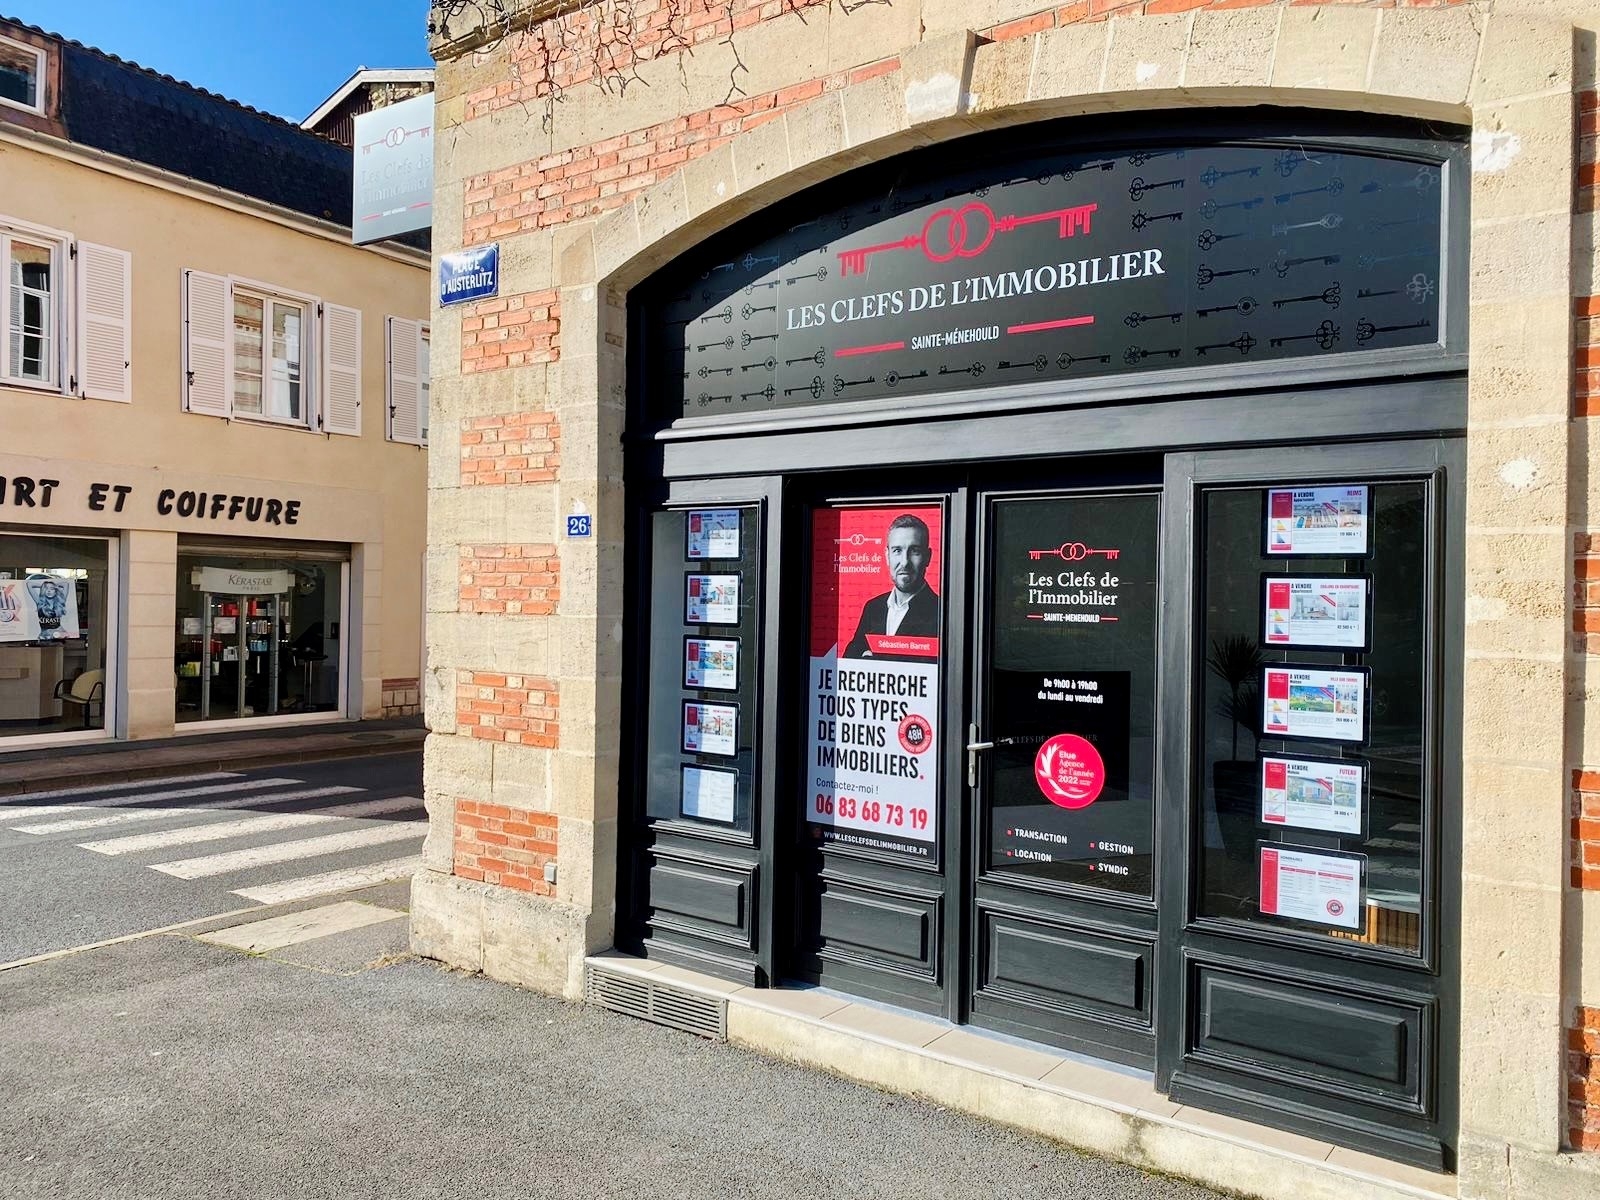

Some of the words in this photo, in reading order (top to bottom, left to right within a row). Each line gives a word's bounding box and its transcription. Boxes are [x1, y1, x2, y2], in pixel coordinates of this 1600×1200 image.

[441, 271, 494, 296] D'AUSTERLITZ
[786, 303, 826, 331] LES
[830, 290, 904, 323] CLEFS
[908, 283, 946, 312] DE
[950, 248, 1166, 306] L'IMMOBILIER
[911, 325, 1000, 350] SAINTE-MÉNEHOULD
[88, 483, 132, 512] ET
[157, 488, 302, 525] COIFFURE
[569, 517, 587, 534] 26
[834, 552, 846, 562] Les
[849, 552, 869, 562] Clefs
[871, 553, 882, 563] de
[1029, 572, 1053, 586] Les
[1057, 571, 1096, 587] Clefs
[1100, 571, 1120, 587] de
[1028, 589, 1118, 606] l'Immobilier
[878, 639, 909, 650] Sébastien
[818, 668, 833, 690] JE
[838, 670, 928, 698] RECHERCHE
[1043, 678, 1053, 688] De
[1053, 679, 1071, 689] 9h00
[1077, 680, 1098, 691] 19h00
[1037, 690, 1047, 700] du
[1047, 691, 1064, 701] lundi
[1065, 693, 1074, 702] au
[1074, 693, 1104, 704] vendredi
[818, 694, 856, 718] TOUS
[861, 699, 909, 722] TYPES
[817, 720, 836, 743] DE
[841, 723, 886, 748] BIENS
[817, 746, 925, 780] IMMOBILIERS.
[1058, 760, 1085, 769] Agence
[1058, 767, 1068, 775] de
[816, 777, 874, 794] Contactez-moi
[1058, 775, 1079, 785] 2022
[816, 794, 834, 815] 06
[838, 797, 857, 819] 83
[861, 801, 881, 823] 68
[886, 804, 904, 826] 73
[909, 807, 928, 830] 19
[823, 830, 928, 856] WWW.LESCLEFSDELIMMOBILIER.FR
[1014, 828, 1068, 845] TRANSACTION
[1014, 849, 1052, 863] LOCATION
[1099, 841, 1134, 855] GESTION
[1098, 863, 1129, 876] SYNDIC
